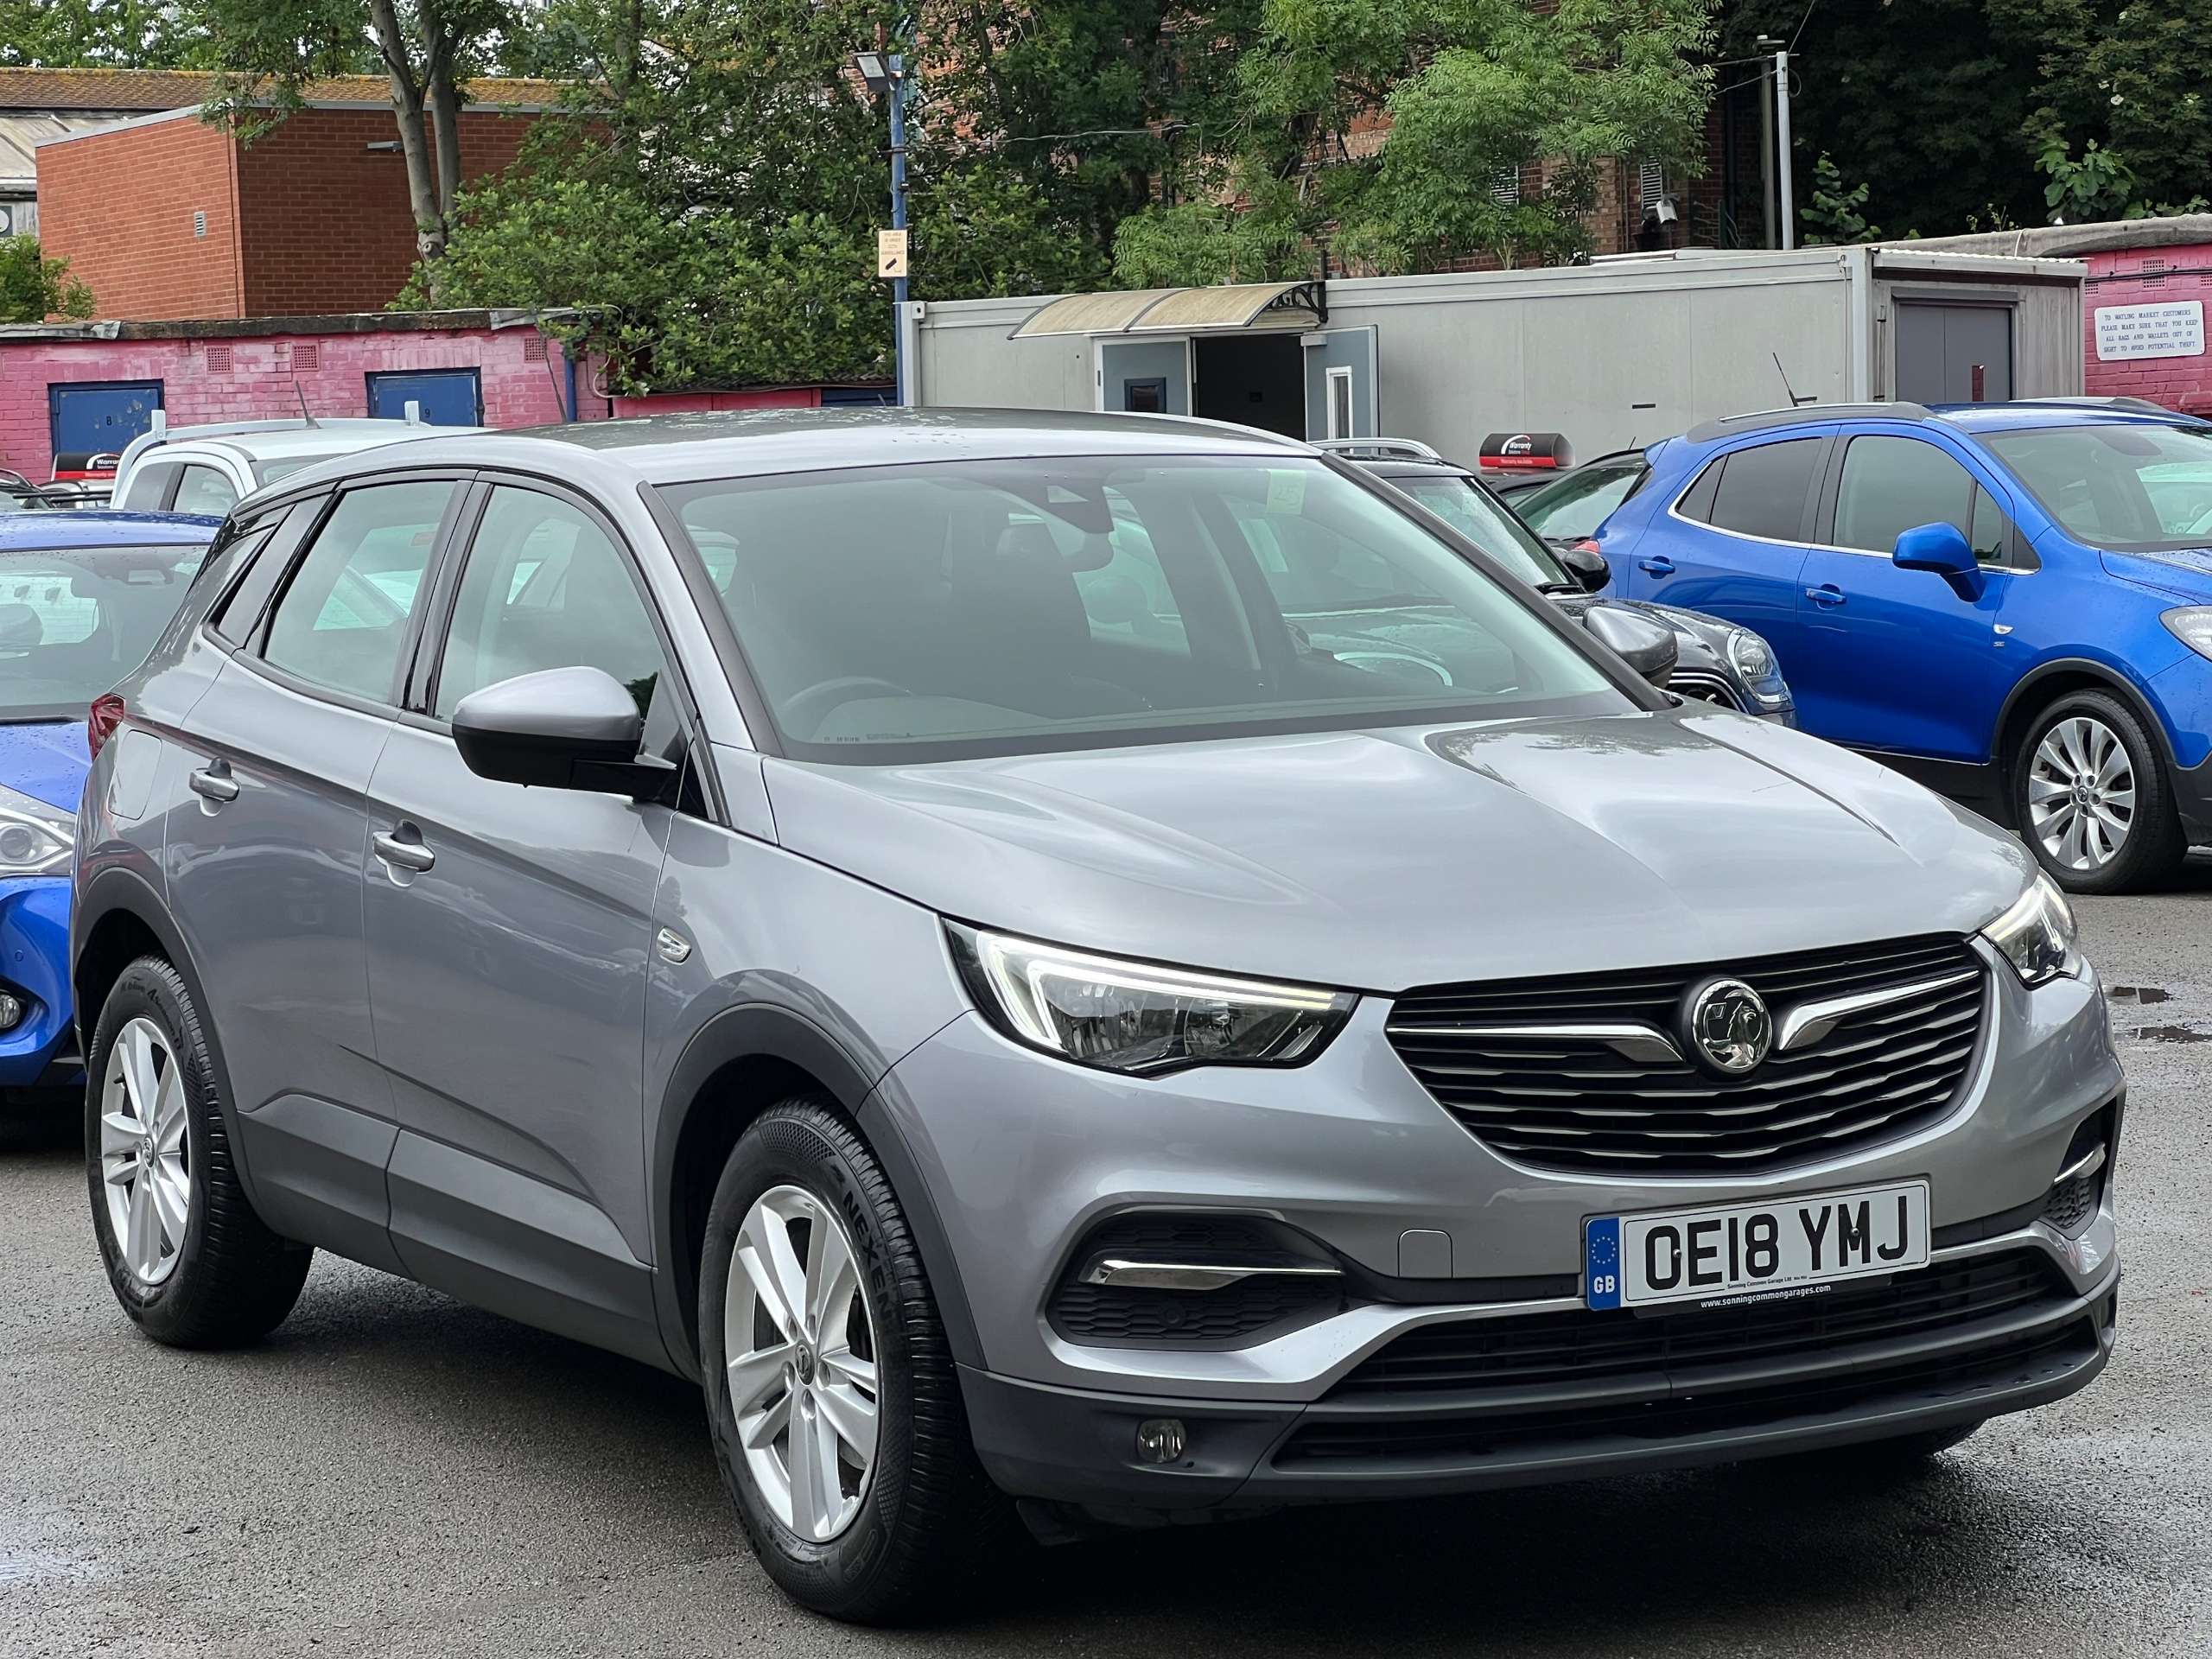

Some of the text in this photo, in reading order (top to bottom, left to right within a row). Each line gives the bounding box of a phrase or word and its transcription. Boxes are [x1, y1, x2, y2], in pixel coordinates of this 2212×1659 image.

[425, 408, 430, 418] 9
[1645, 1196, 1908, 1290] OE18 YMJ
[843, 1191, 893, 1320] NEXEN
[1594, 1275, 1615, 1294] GB
[1700, 1285, 1831, 1308] www.sonningcommongarages.com
